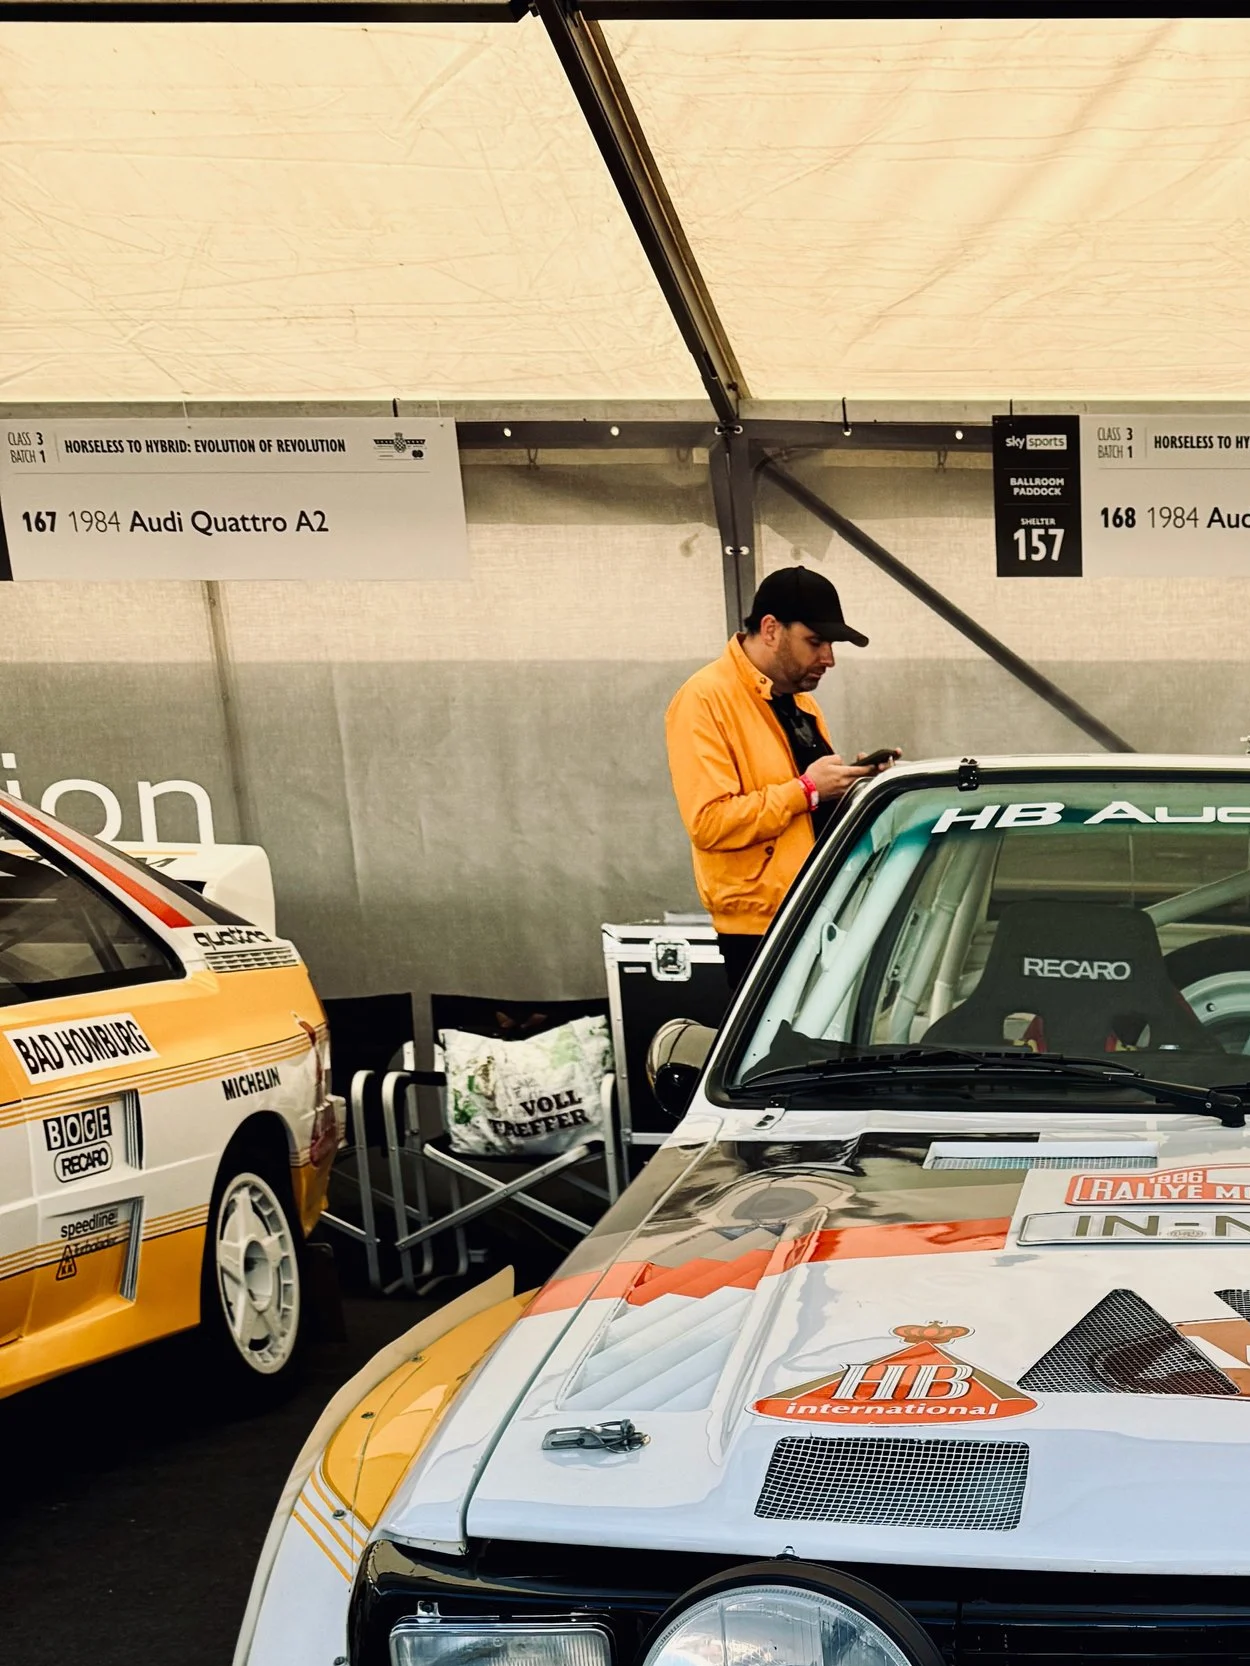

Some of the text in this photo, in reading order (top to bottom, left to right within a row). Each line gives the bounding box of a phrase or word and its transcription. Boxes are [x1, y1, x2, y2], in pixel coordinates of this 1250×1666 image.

[8, 432, 44, 446] CLASS 3
[1005, 435, 1066, 450] sky sports
[1097, 427, 1134, 441] CLASS 3
[1154, 435, 1214, 449] HORSELESS
[1217, 435, 1232, 449] TO
[11, 450, 46, 464] BATCH 1
[64, 438, 346, 454] HORSELESS TO HYBRID: EVOLUTION OF REVOLUTION
[1098, 445, 1133, 459] BATCH 1
[1010, 477, 1065, 486] BALLROOM
[1013, 487, 1062, 496] PADDOCK
[22, 510, 330, 537] 167 1984 Audi Quattro A2
[1020, 517, 1057, 526] SHELTER
[1100, 506, 1137, 529] 168
[1147, 506, 1200, 529] 1984
[1013, 528, 1065, 562] 157
[931, 802, 1066, 834] HB
[193, 926, 273, 951] quattro
[1023, 957, 1132, 982] RECARO
[13, 1020, 151, 1075] BAD HOMBURG
[221, 1066, 282, 1101] MICHELIN
[520, 1089, 583, 1117] VOLL
[45, 1107, 111, 1150] BOGE
[61, 1147, 109, 1176] RECARO
[1149, 1170, 1204, 1185] 1986
[1091, 1179, 1203, 1201] RALLYE
[60, 1211, 119, 1241] speedline
[831, 1363, 975, 1401] HB
[785, 1402, 999, 1416] international
